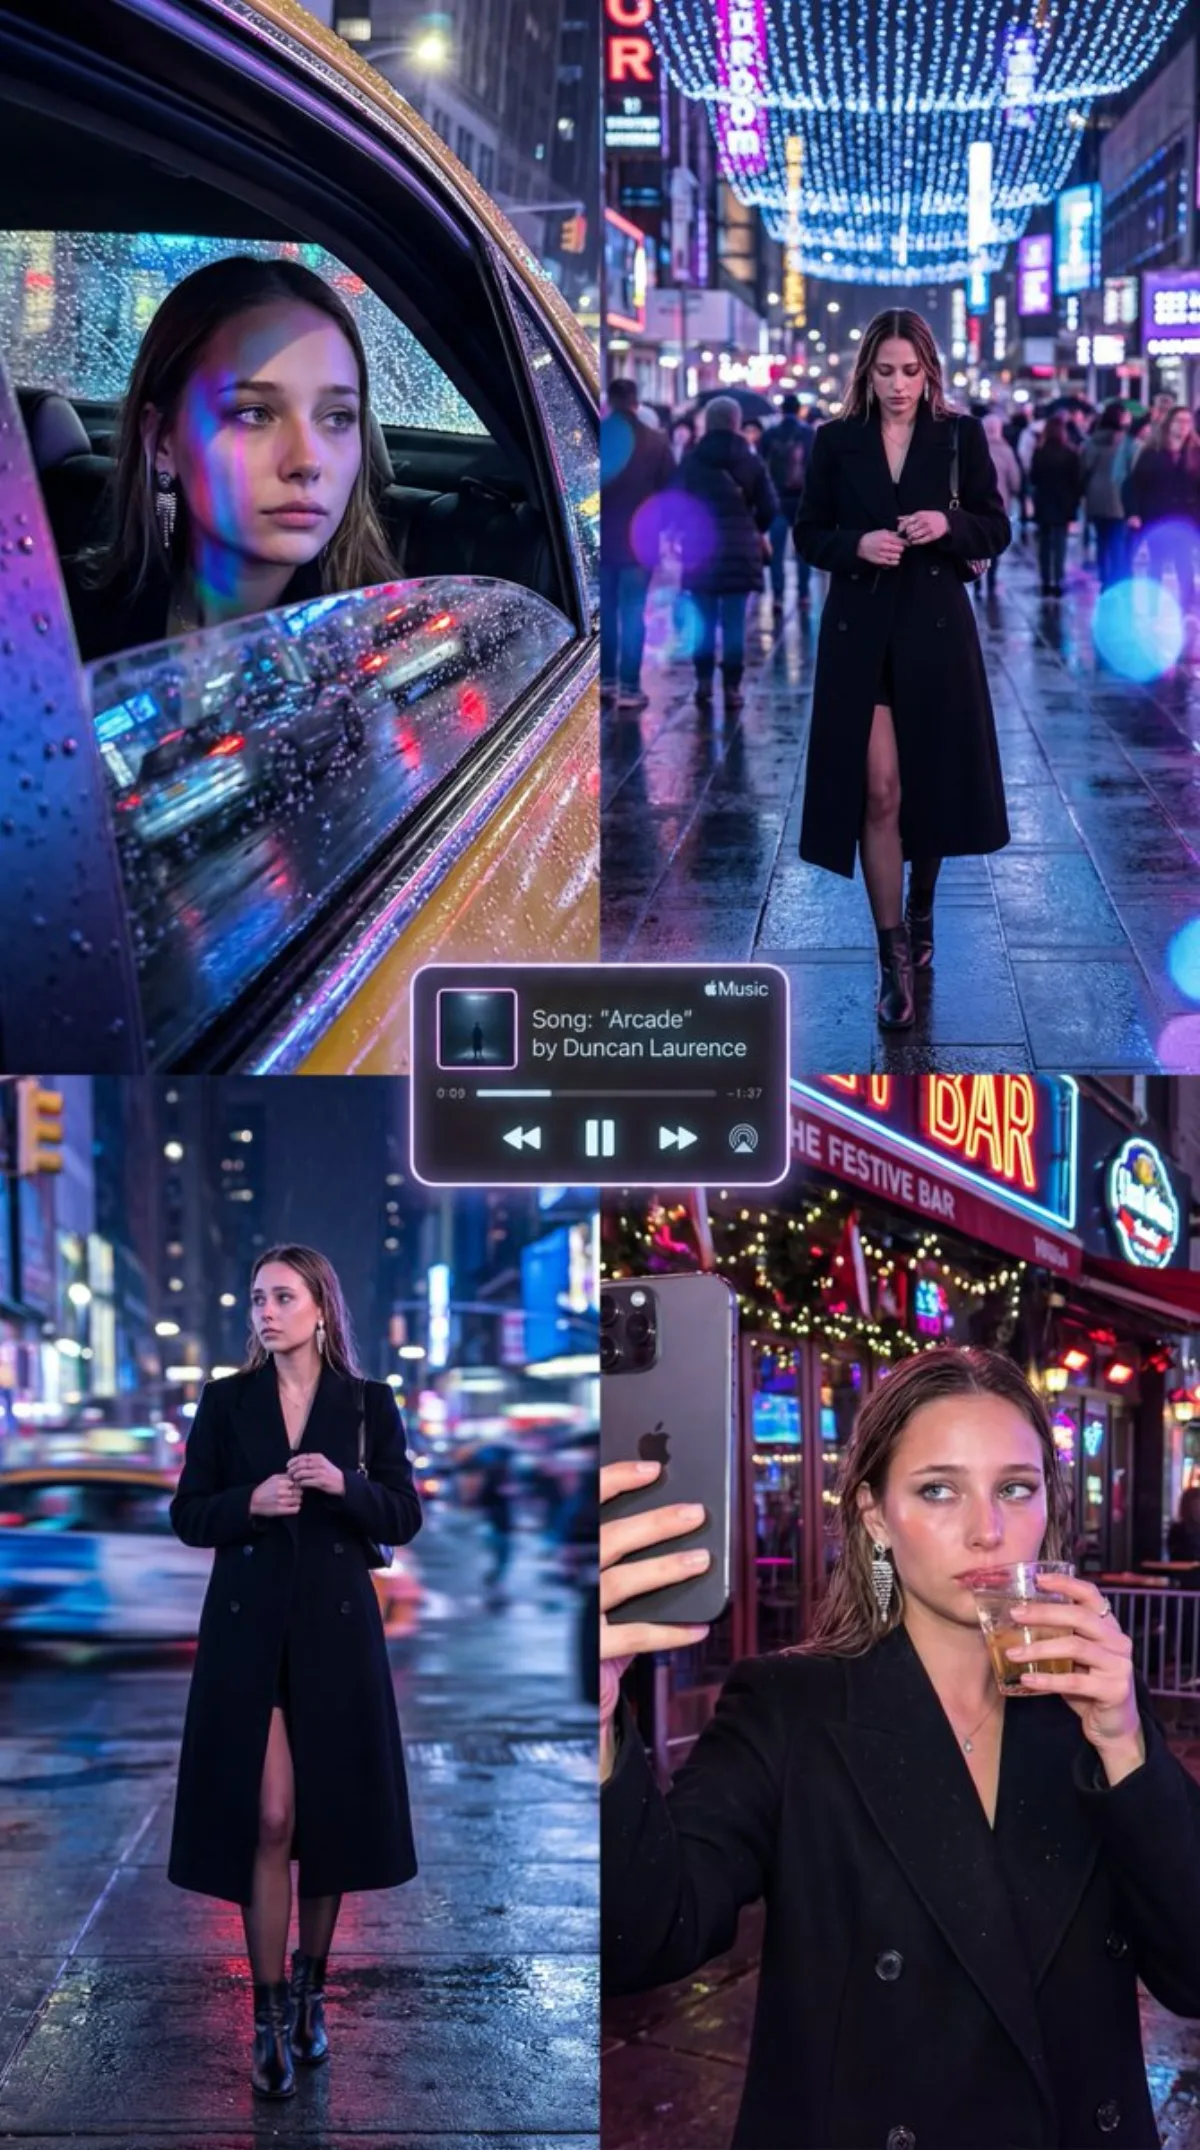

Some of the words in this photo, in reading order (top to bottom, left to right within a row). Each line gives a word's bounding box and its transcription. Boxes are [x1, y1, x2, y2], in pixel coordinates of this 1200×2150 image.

[790, 1116, 823, 1161] HE
[828, 1134, 915, 1203] FESTIVE
[917, 1177, 956, 1220] BAR
[929, 1075, 1036, 1188] BAR
